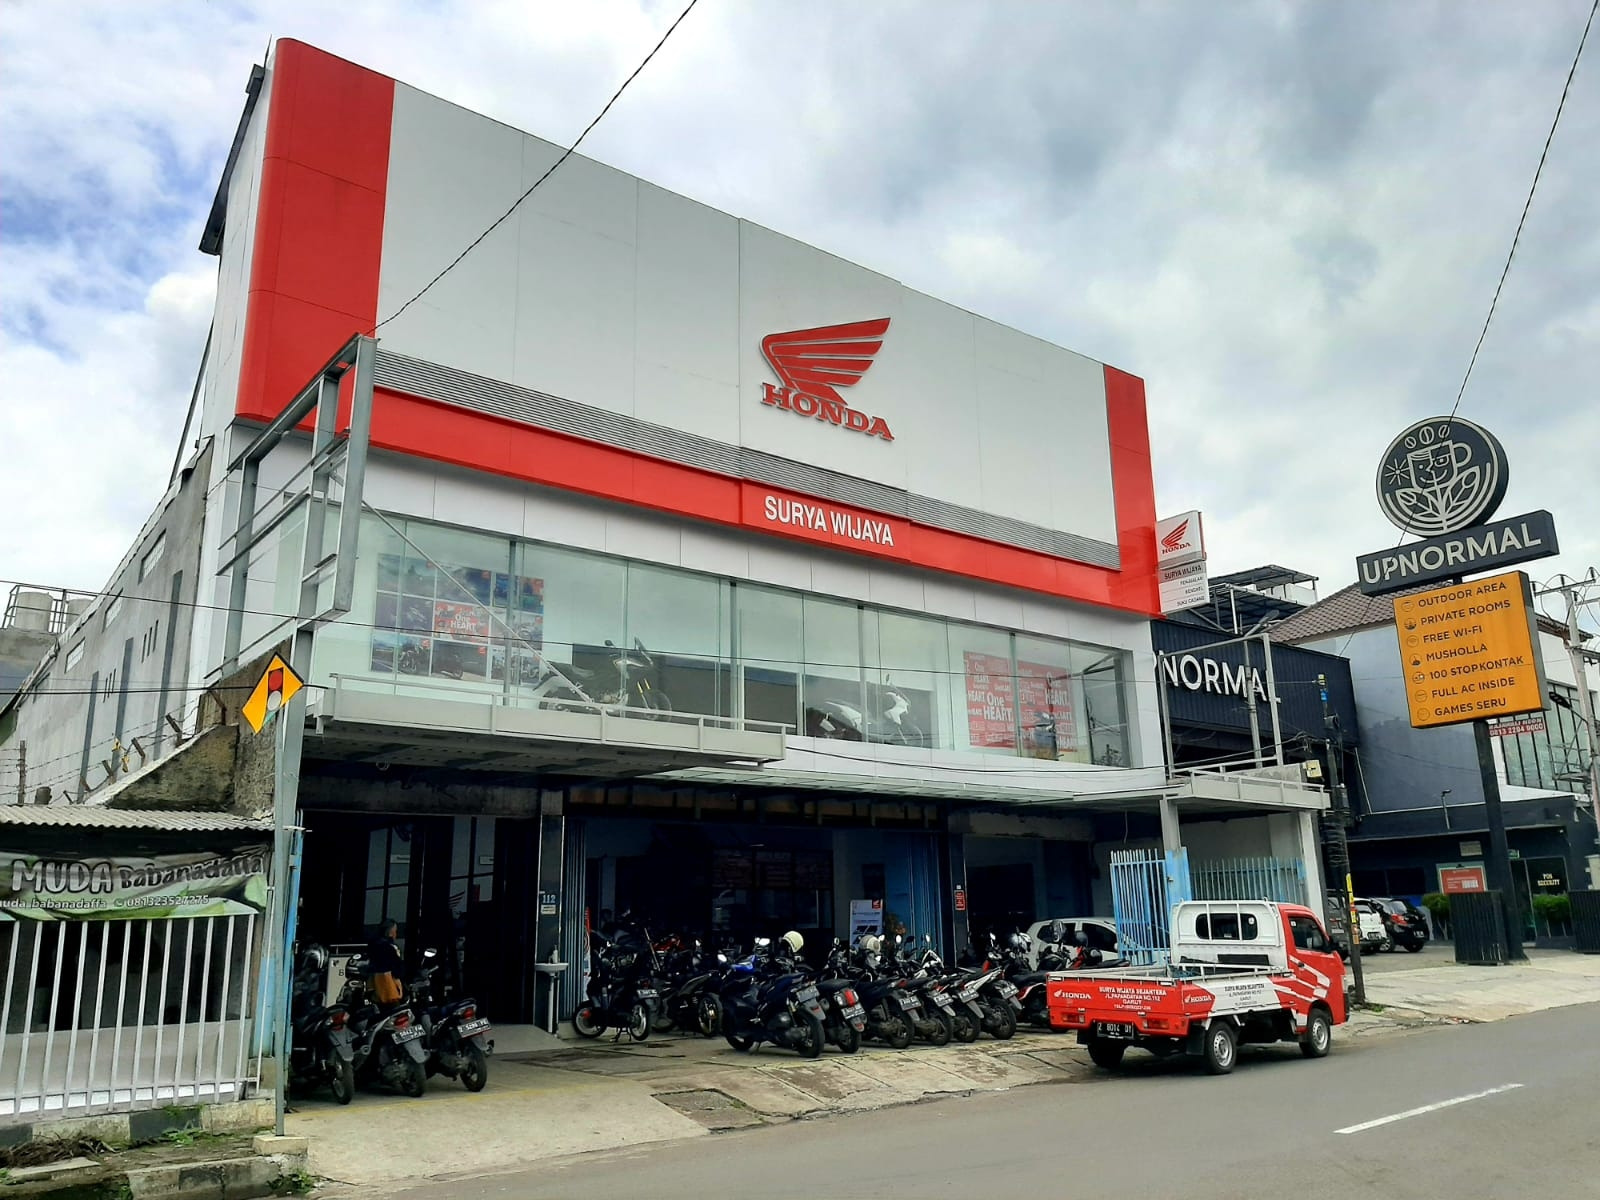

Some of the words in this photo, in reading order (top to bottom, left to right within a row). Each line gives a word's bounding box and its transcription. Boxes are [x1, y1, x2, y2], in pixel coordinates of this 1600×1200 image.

[760, 383, 894, 440] HONDA
[764, 495, 828, 532] SURYA
[831, 510, 894, 546] WIJAYA
[1162, 542, 1192, 554] HONDA
[1362, 522, 1542, 584] UPNORMAL
[1164, 568, 1182, 580] SURYA
[1182, 564, 1202, 576] WIJAYA
[1418, 590, 1472, 608] OUTDOOR
[1476, 582, 1507, 594] AREA
[1421, 610, 1465, 626] PRIVATE
[1469, 600, 1510, 616] ROOMS
[1424, 631, 1450, 644] FREE
[1454, 626, 1482, 638] WI-FI
[1426, 644, 1488, 662] MUSHOLLA
[1430, 669, 1448, 680] 100
[1451, 656, 1524, 676] STOPKONTAK
[1432, 685, 1458, 698] FULL
[1462, 684, 1476, 693] AC
[1478, 677, 1516, 690] INSIDE
[986, 692, 1004, 706] One
[1434, 703, 1474, 716] GAMES
[1476, 698, 1506, 710] SERU
[12, 858, 113, 894] MUDA
[542, 894, 556, 904] 112
